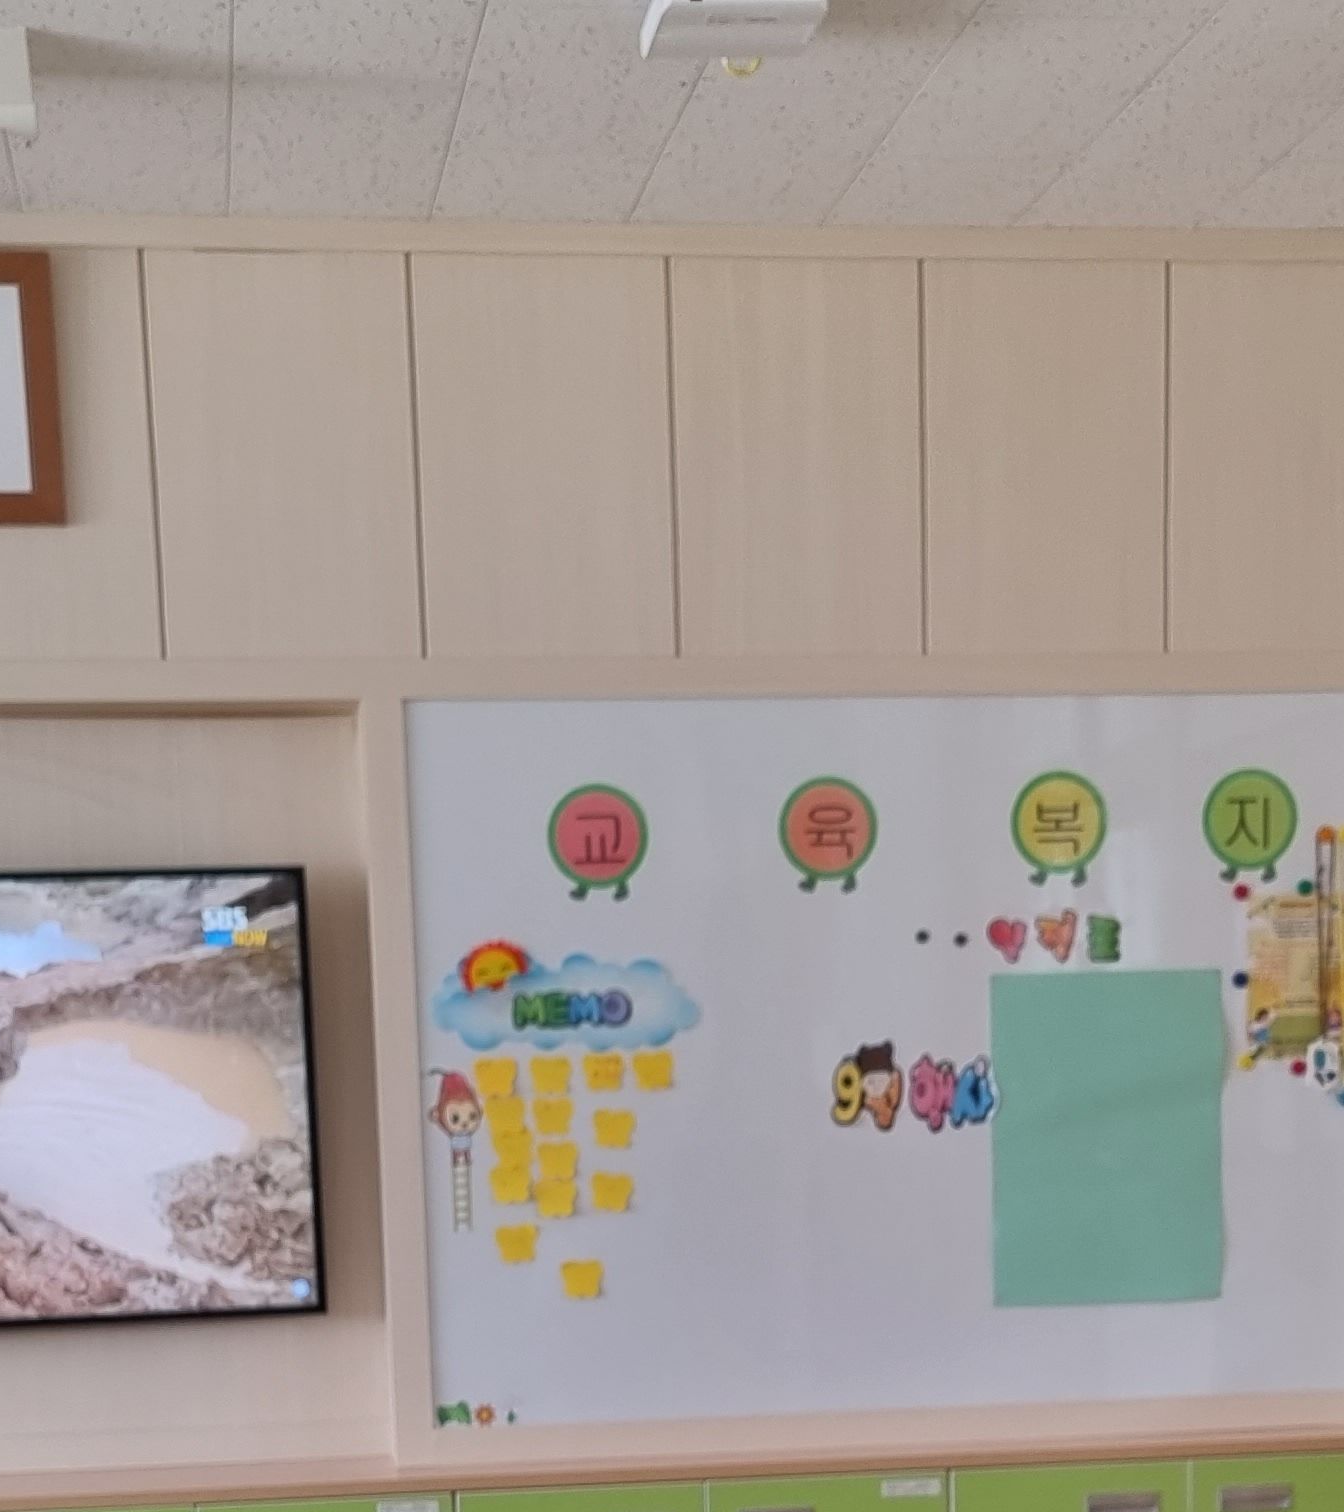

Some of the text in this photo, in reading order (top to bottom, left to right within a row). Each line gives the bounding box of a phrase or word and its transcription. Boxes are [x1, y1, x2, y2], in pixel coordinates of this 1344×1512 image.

[573, 795, 1273, 868] 교 육 복 지
[512, 991, 633, 1030] MEMO
